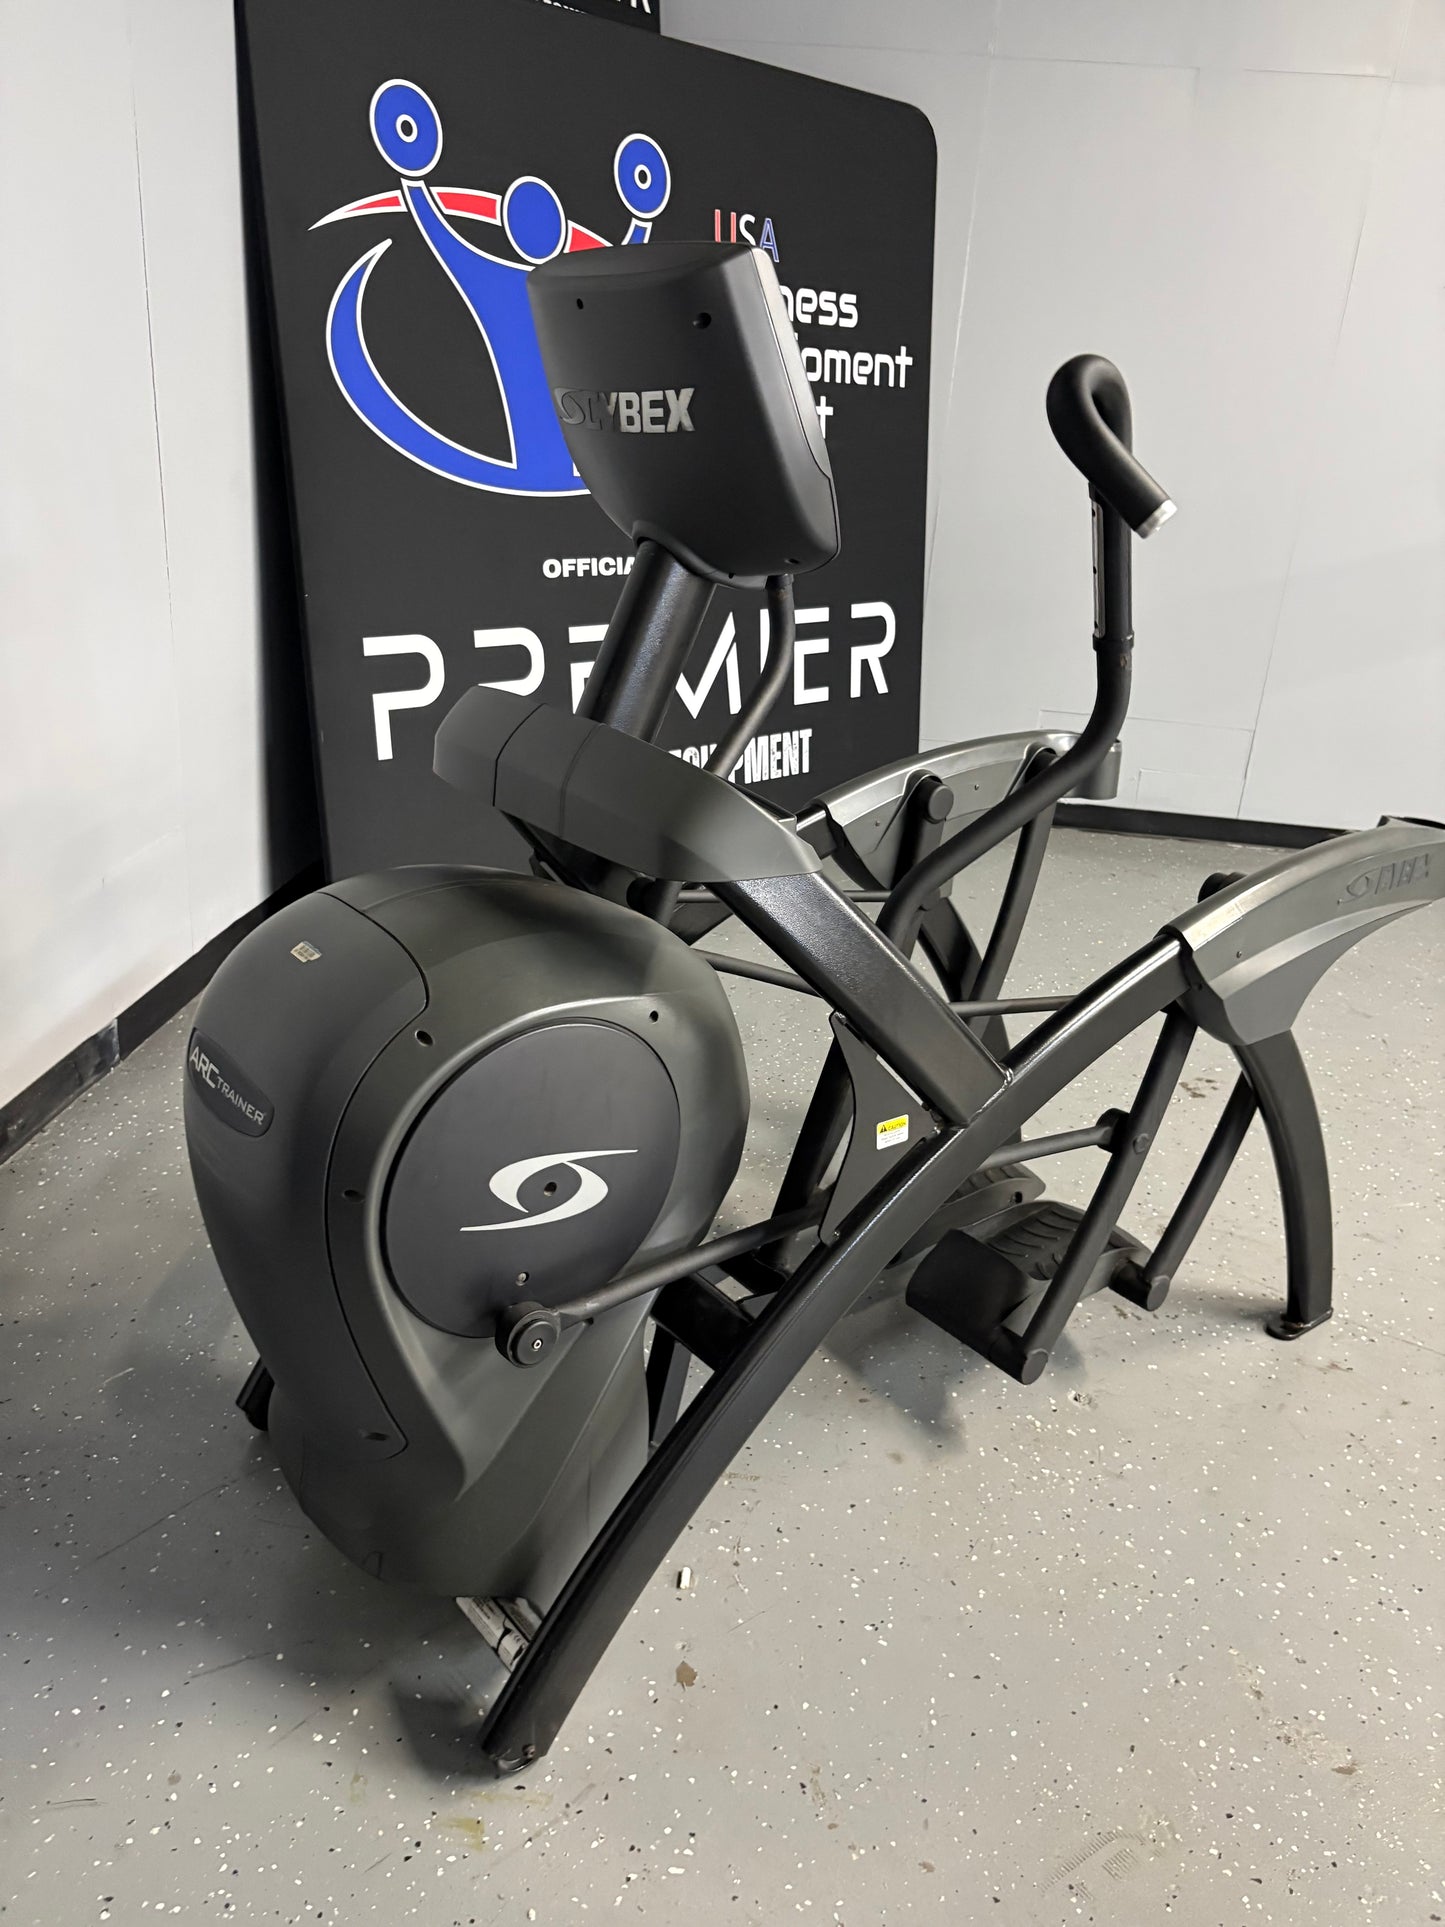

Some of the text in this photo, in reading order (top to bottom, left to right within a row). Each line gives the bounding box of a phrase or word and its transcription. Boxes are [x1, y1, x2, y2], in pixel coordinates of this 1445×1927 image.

[714, 208, 780, 263] USA
[778, 284, 859, 328] ness
[542, 556, 636, 579] OFFICIA
[189, 1046, 265, 1125] ARC TRAINER
